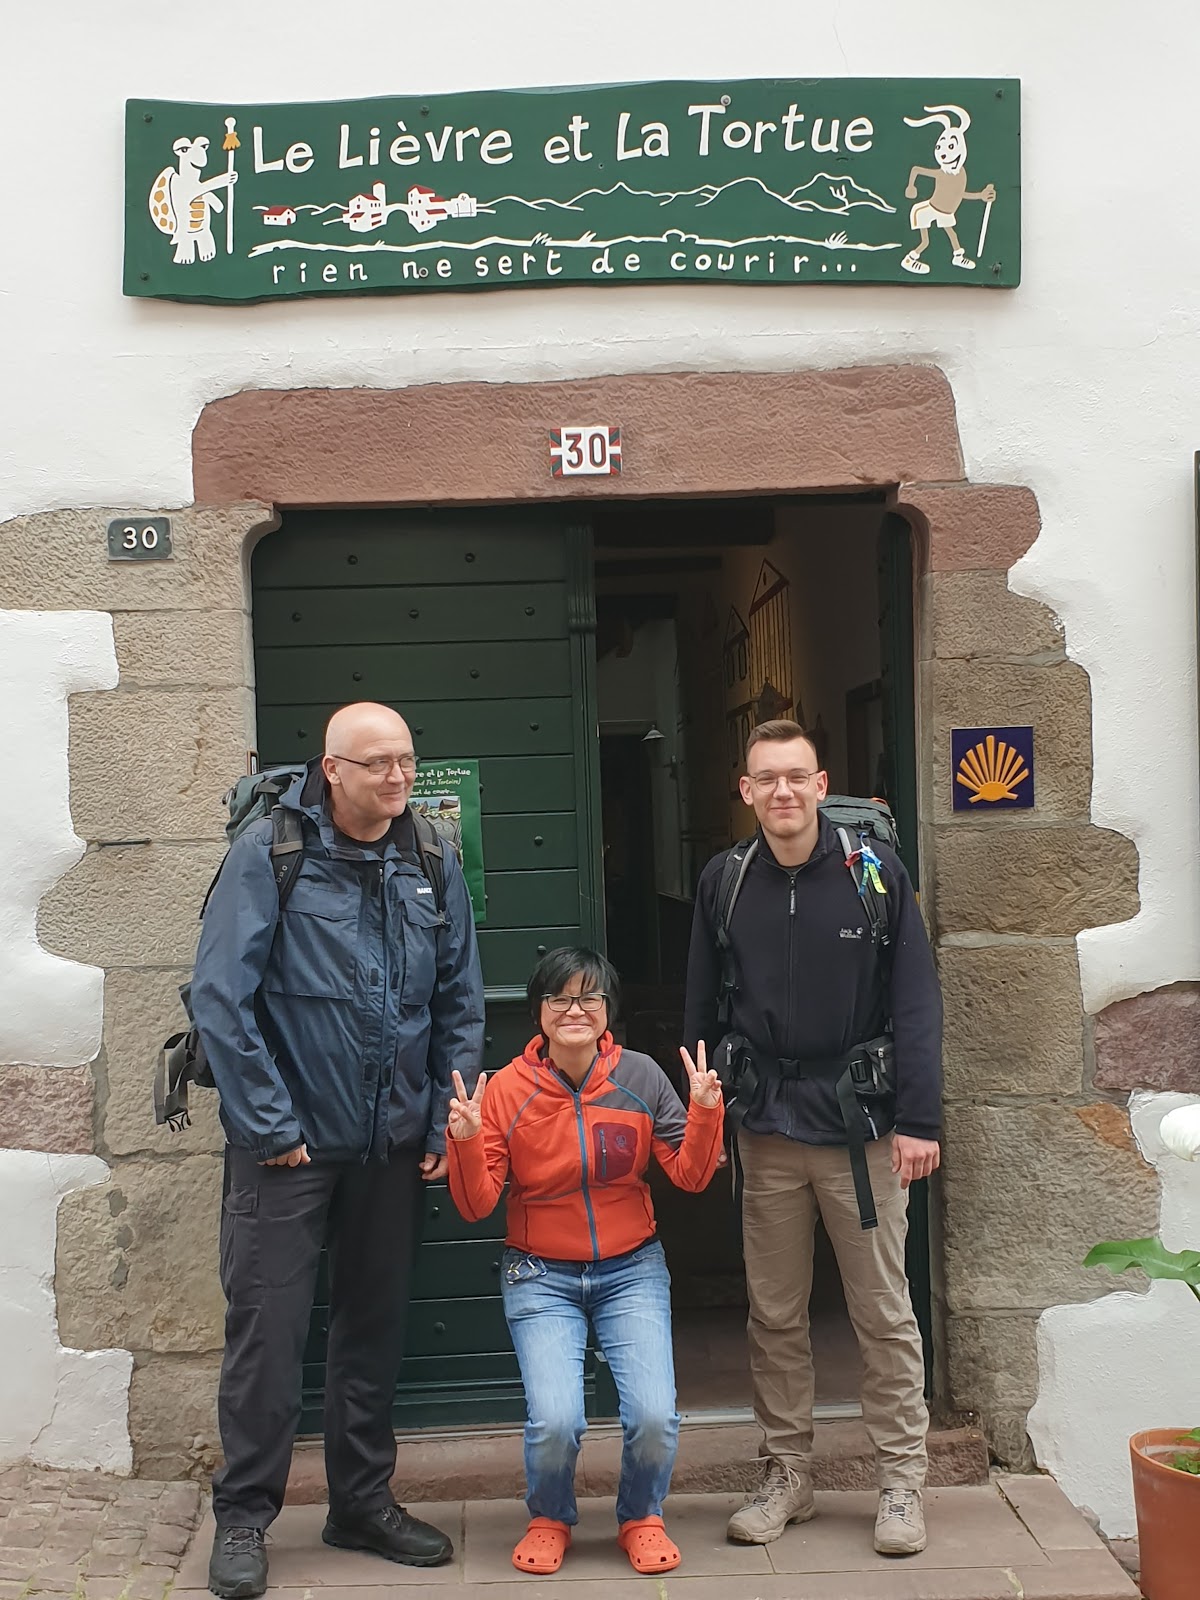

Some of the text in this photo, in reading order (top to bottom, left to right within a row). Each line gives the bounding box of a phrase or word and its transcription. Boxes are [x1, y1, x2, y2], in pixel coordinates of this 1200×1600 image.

[253, 103, 874, 174] Le Lièvre et La Tortue
[271, 261, 368, 285] rien
[402, 256, 452, 280] ne
[475, 248, 564, 277] sert
[591, 248, 641, 275] de
[565, 432, 607, 469] 30
[122, 525, 158, 549] 30
[426, 768, 435, 778] et
[445, 767, 471, 777] Tortue
